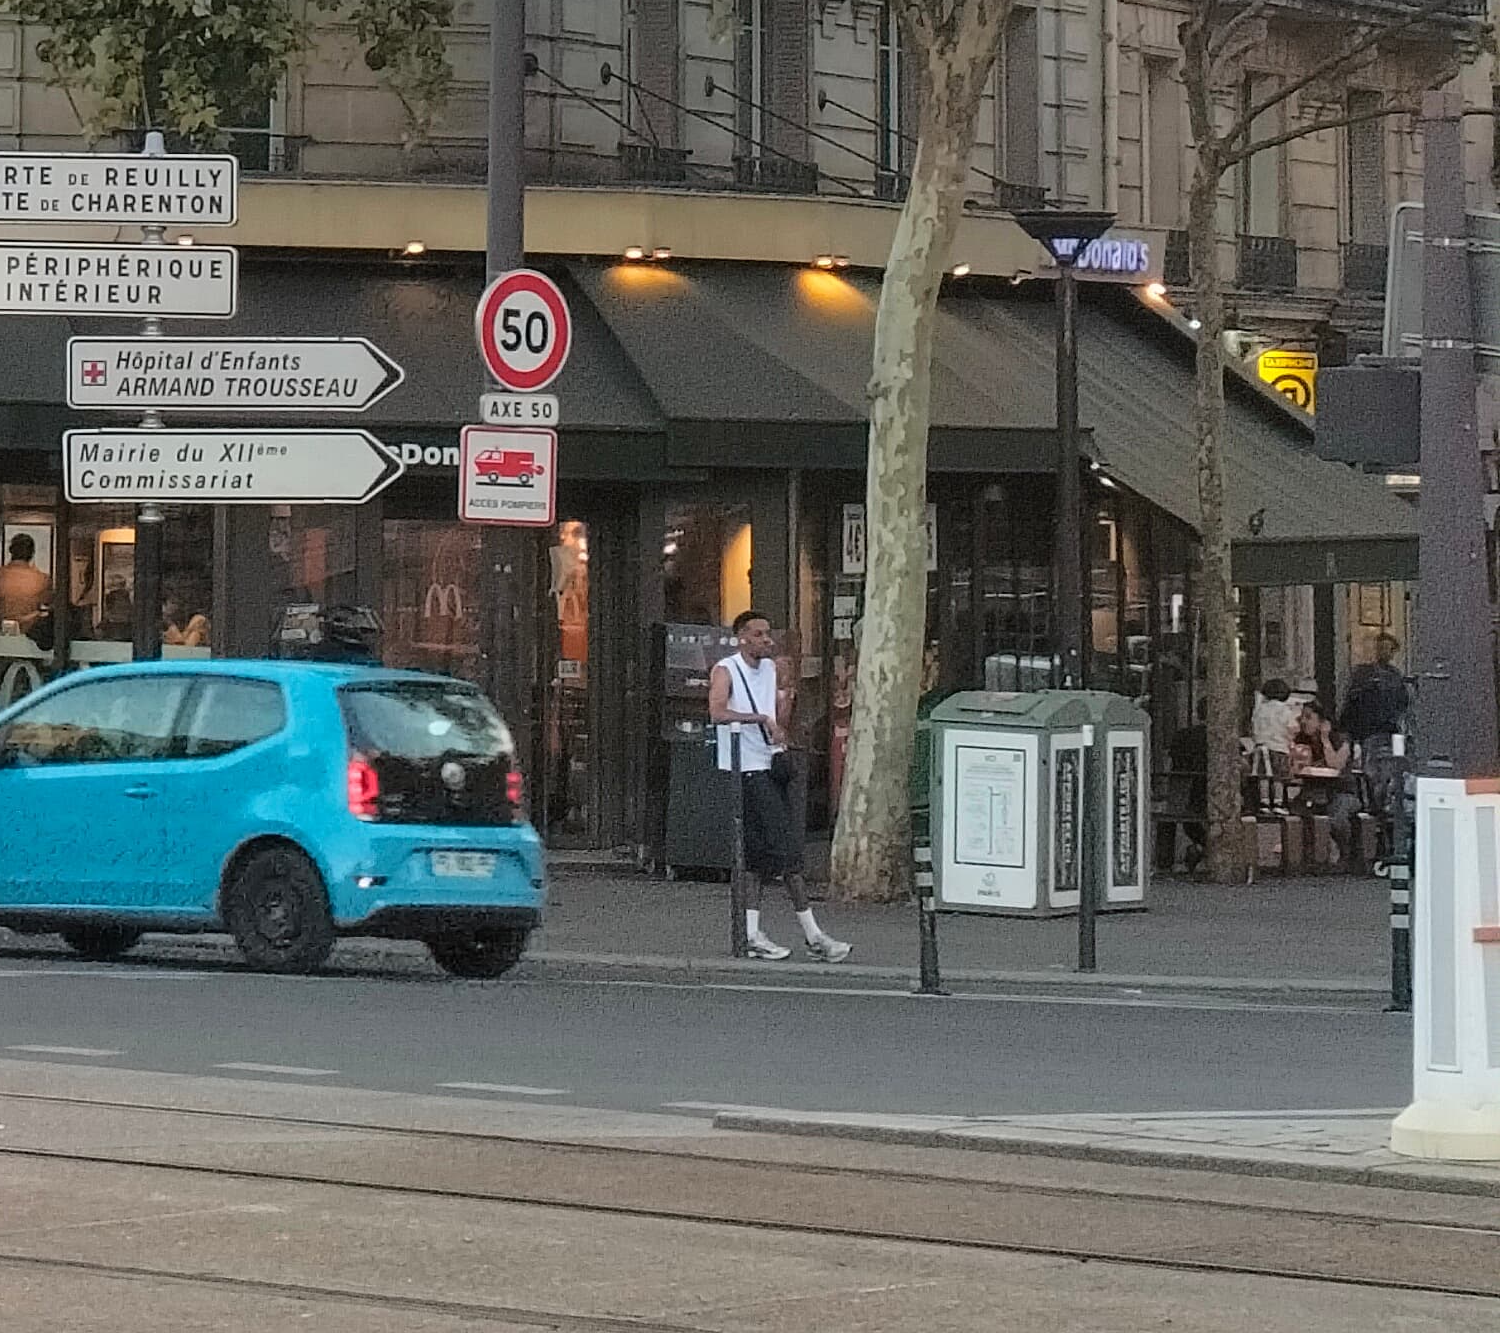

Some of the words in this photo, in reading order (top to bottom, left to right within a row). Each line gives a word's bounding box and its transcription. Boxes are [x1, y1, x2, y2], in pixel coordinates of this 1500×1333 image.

[68, 173, 89, 186] DE
[105, 168, 223, 188] REUILLY
[40, 199, 59, 212] DE
[71, 194, 223, 214] CHARENTON
[6, 253, 223, 280] PÉRIPHÉRIQUE
[6, 280, 162, 304] INTÉRIEUR
[500, 308, 549, 354] 50
[116, 350, 193, 375] Hôpital
[201, 351, 301, 371] d'Enfants
[116, 378, 214, 397] ARMAND
[225, 378, 358, 398] TROUSSEAU
[490, 401, 522, 417] AXE
[531, 403, 552, 418] 50
[79, 443, 160, 463] Mairie
[177, 443, 203, 463] du
[81, 469, 254, 489] Commissariat
[501, 499, 547, 512] POMPIERS
